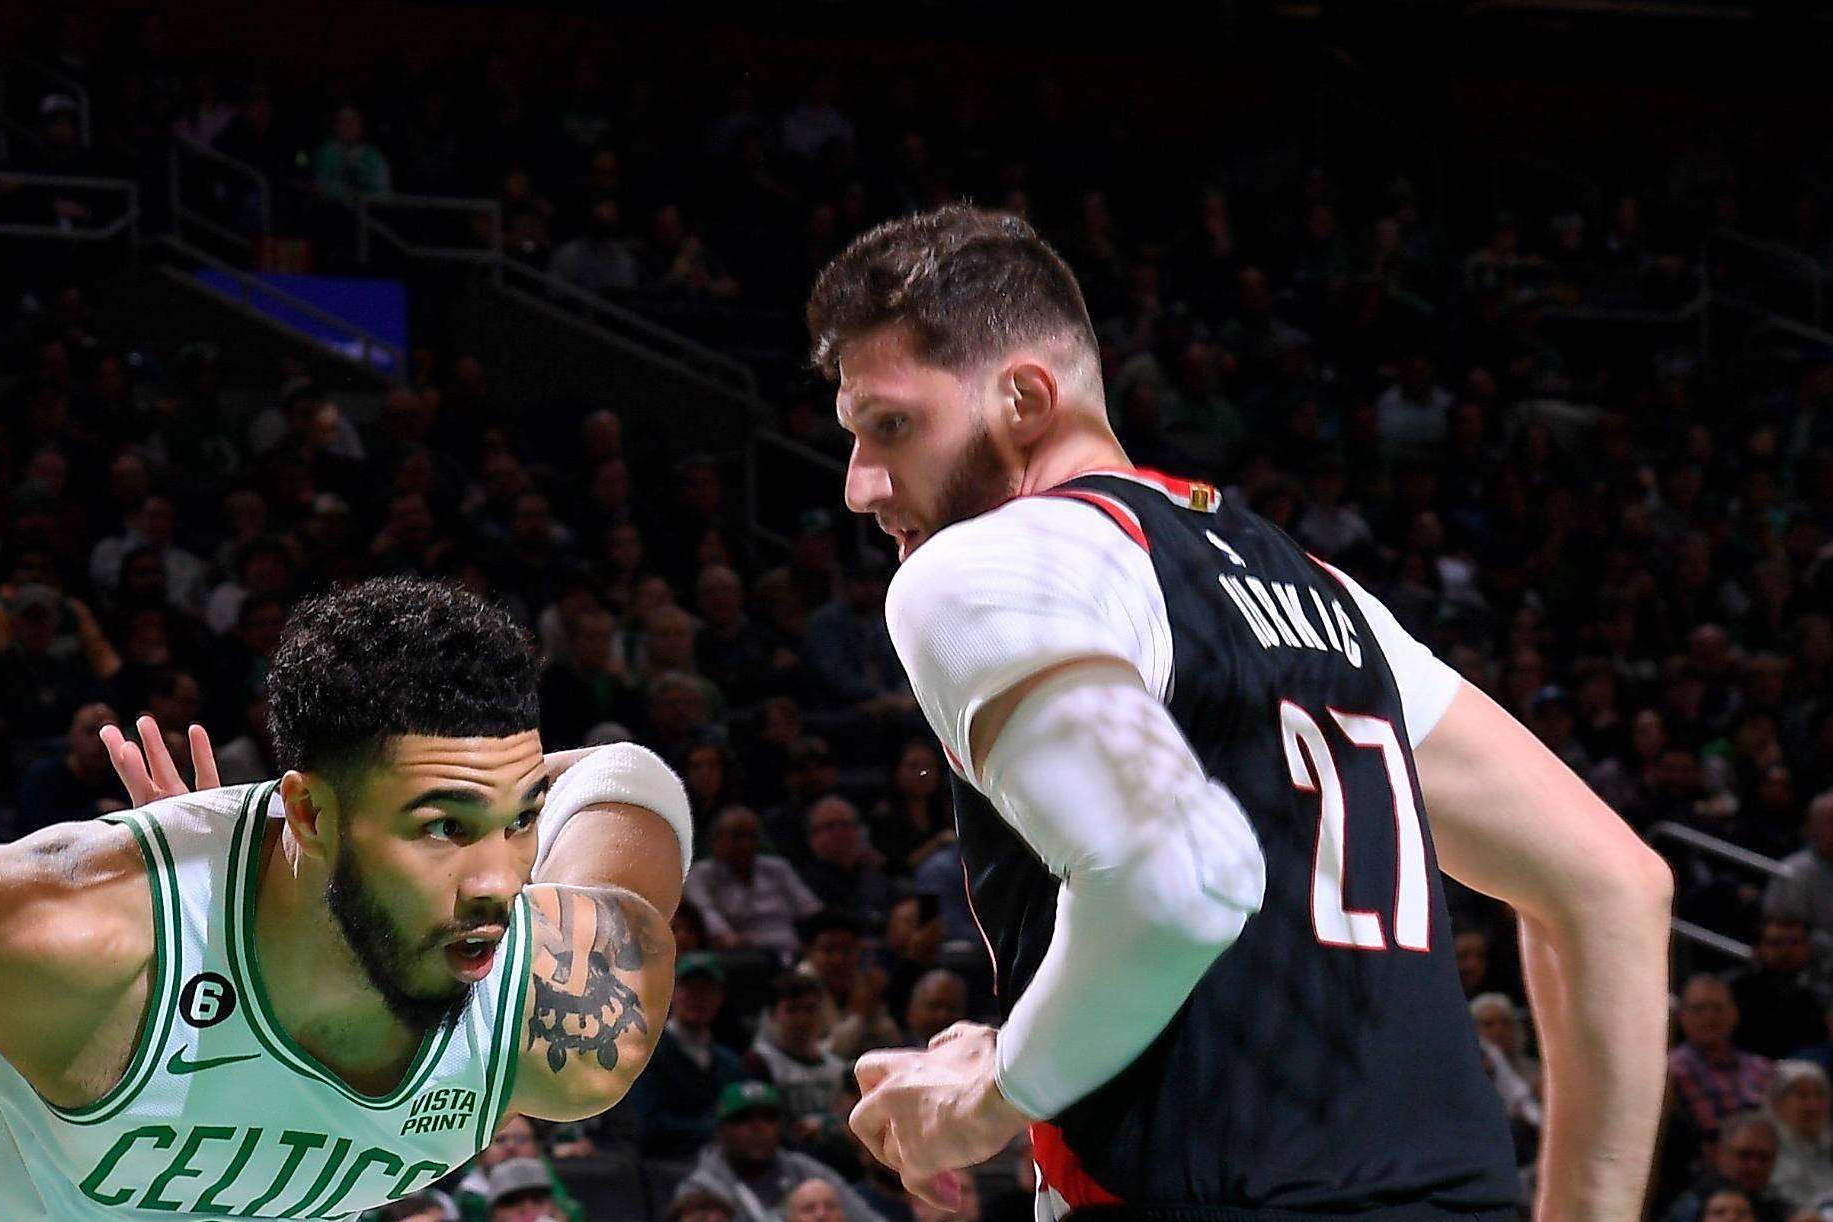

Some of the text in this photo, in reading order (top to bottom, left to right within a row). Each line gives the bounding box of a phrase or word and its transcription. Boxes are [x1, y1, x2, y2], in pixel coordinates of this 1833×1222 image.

[1279, 699, 1431, 952] 27
[189, 979, 224, 1022] 6
[409, 1087, 477, 1117] VISTA
[400, 1112, 472, 1136] PRINT
